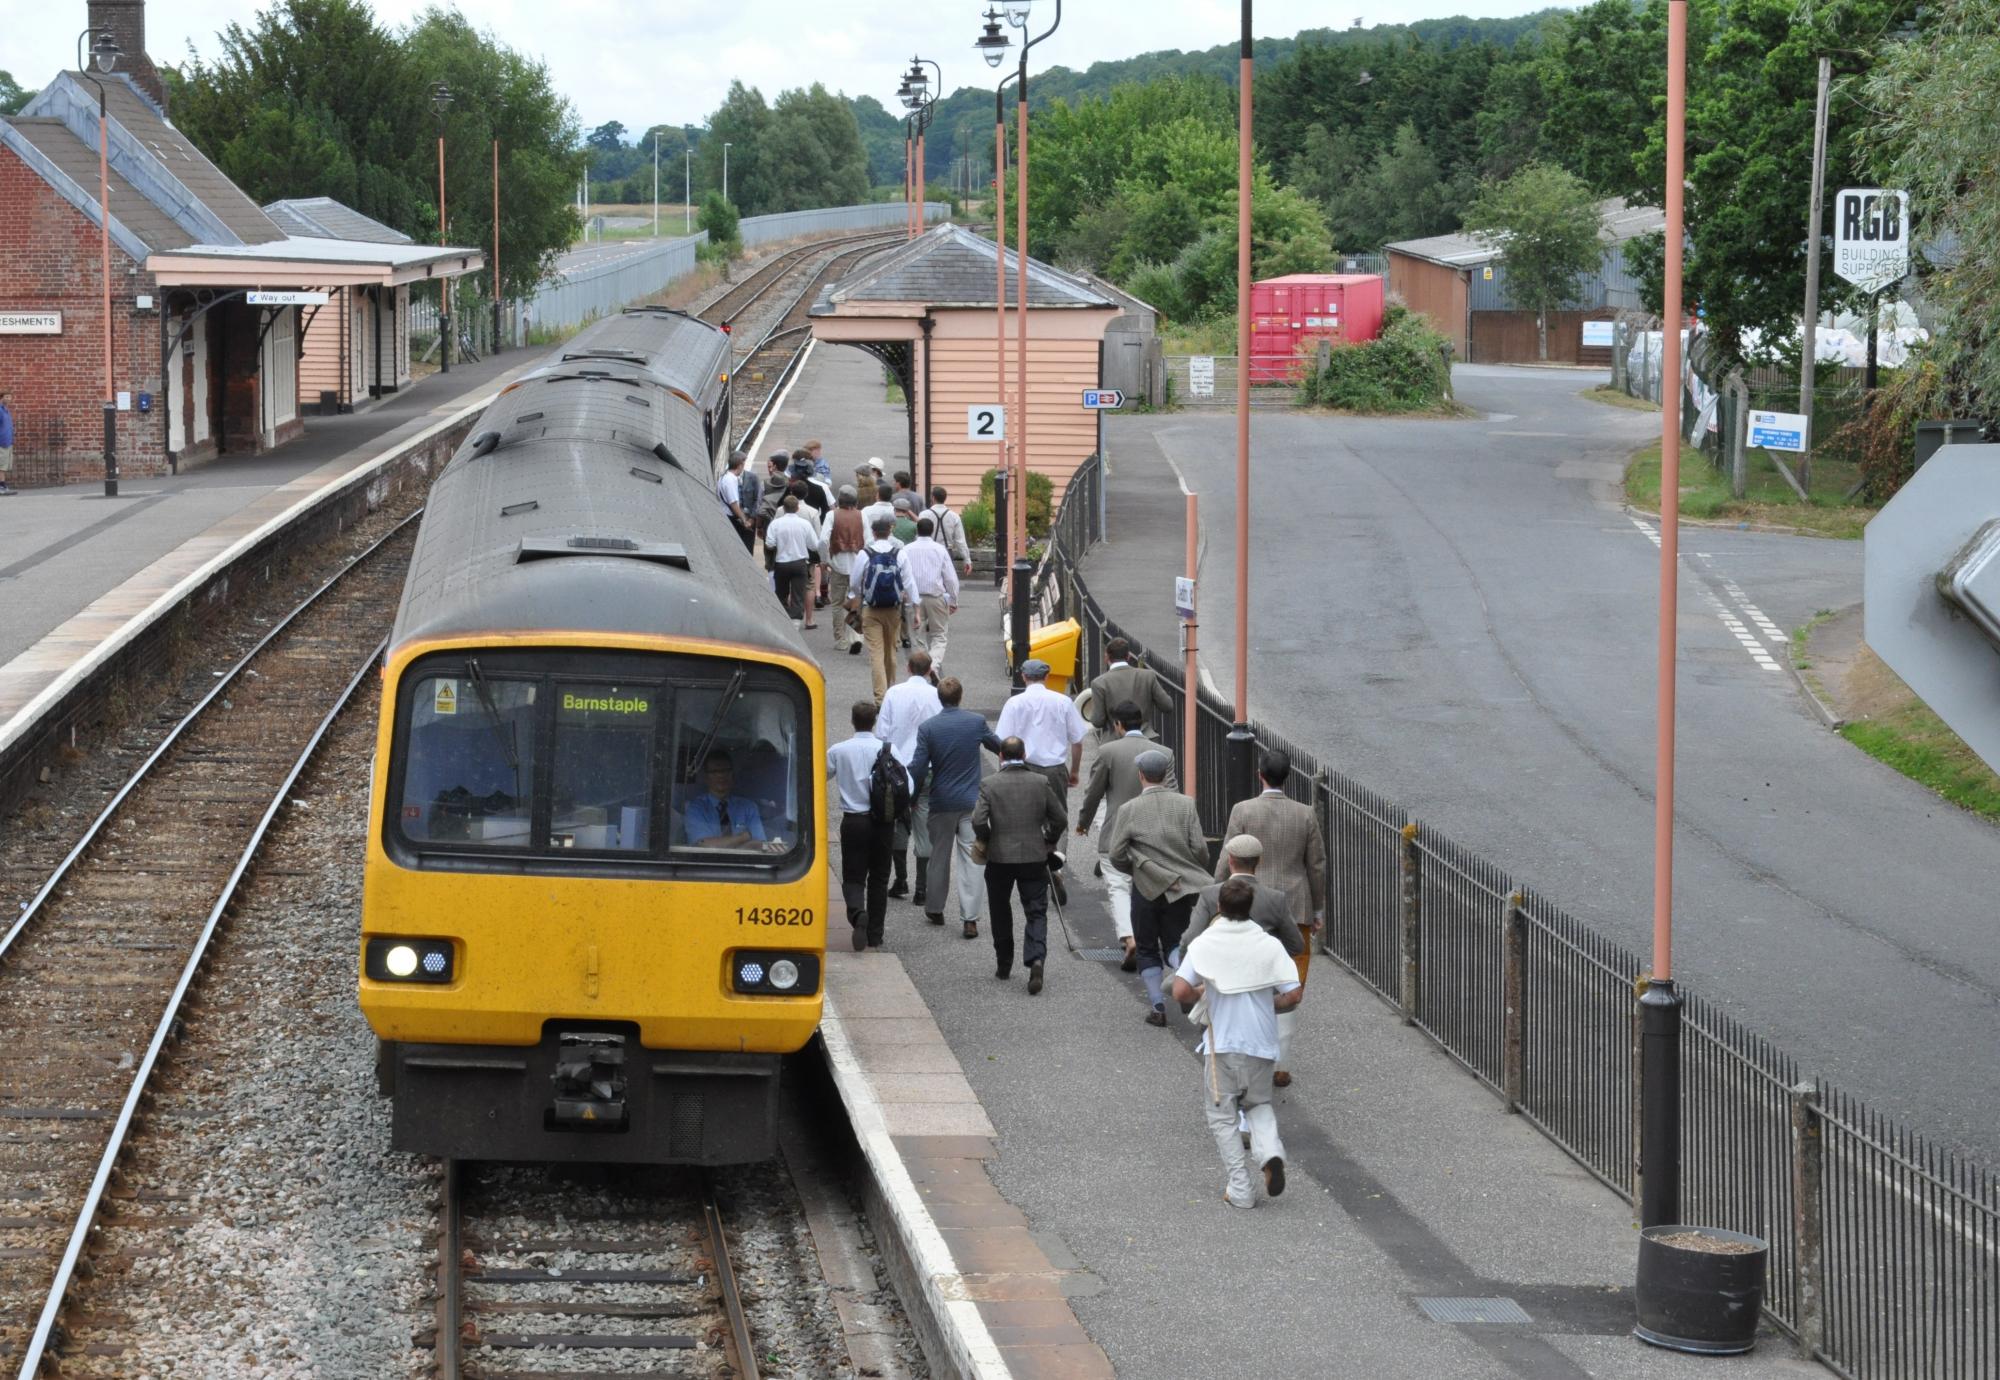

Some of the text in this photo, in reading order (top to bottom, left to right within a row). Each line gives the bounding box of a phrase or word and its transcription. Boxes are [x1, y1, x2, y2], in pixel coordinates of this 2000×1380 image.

[1843, 195, 1901, 241] RGB
[1841, 248, 1900, 261] BUILDING
[260, 294, 278, 302] Way
[0, 317, 56, 326] ESHMENTS
[1087, 394, 1097, 405] P
[976, 411, 995, 435] 2
[563, 694, 648, 714] Barnstaple
[735, 907, 814, 927] 143620
